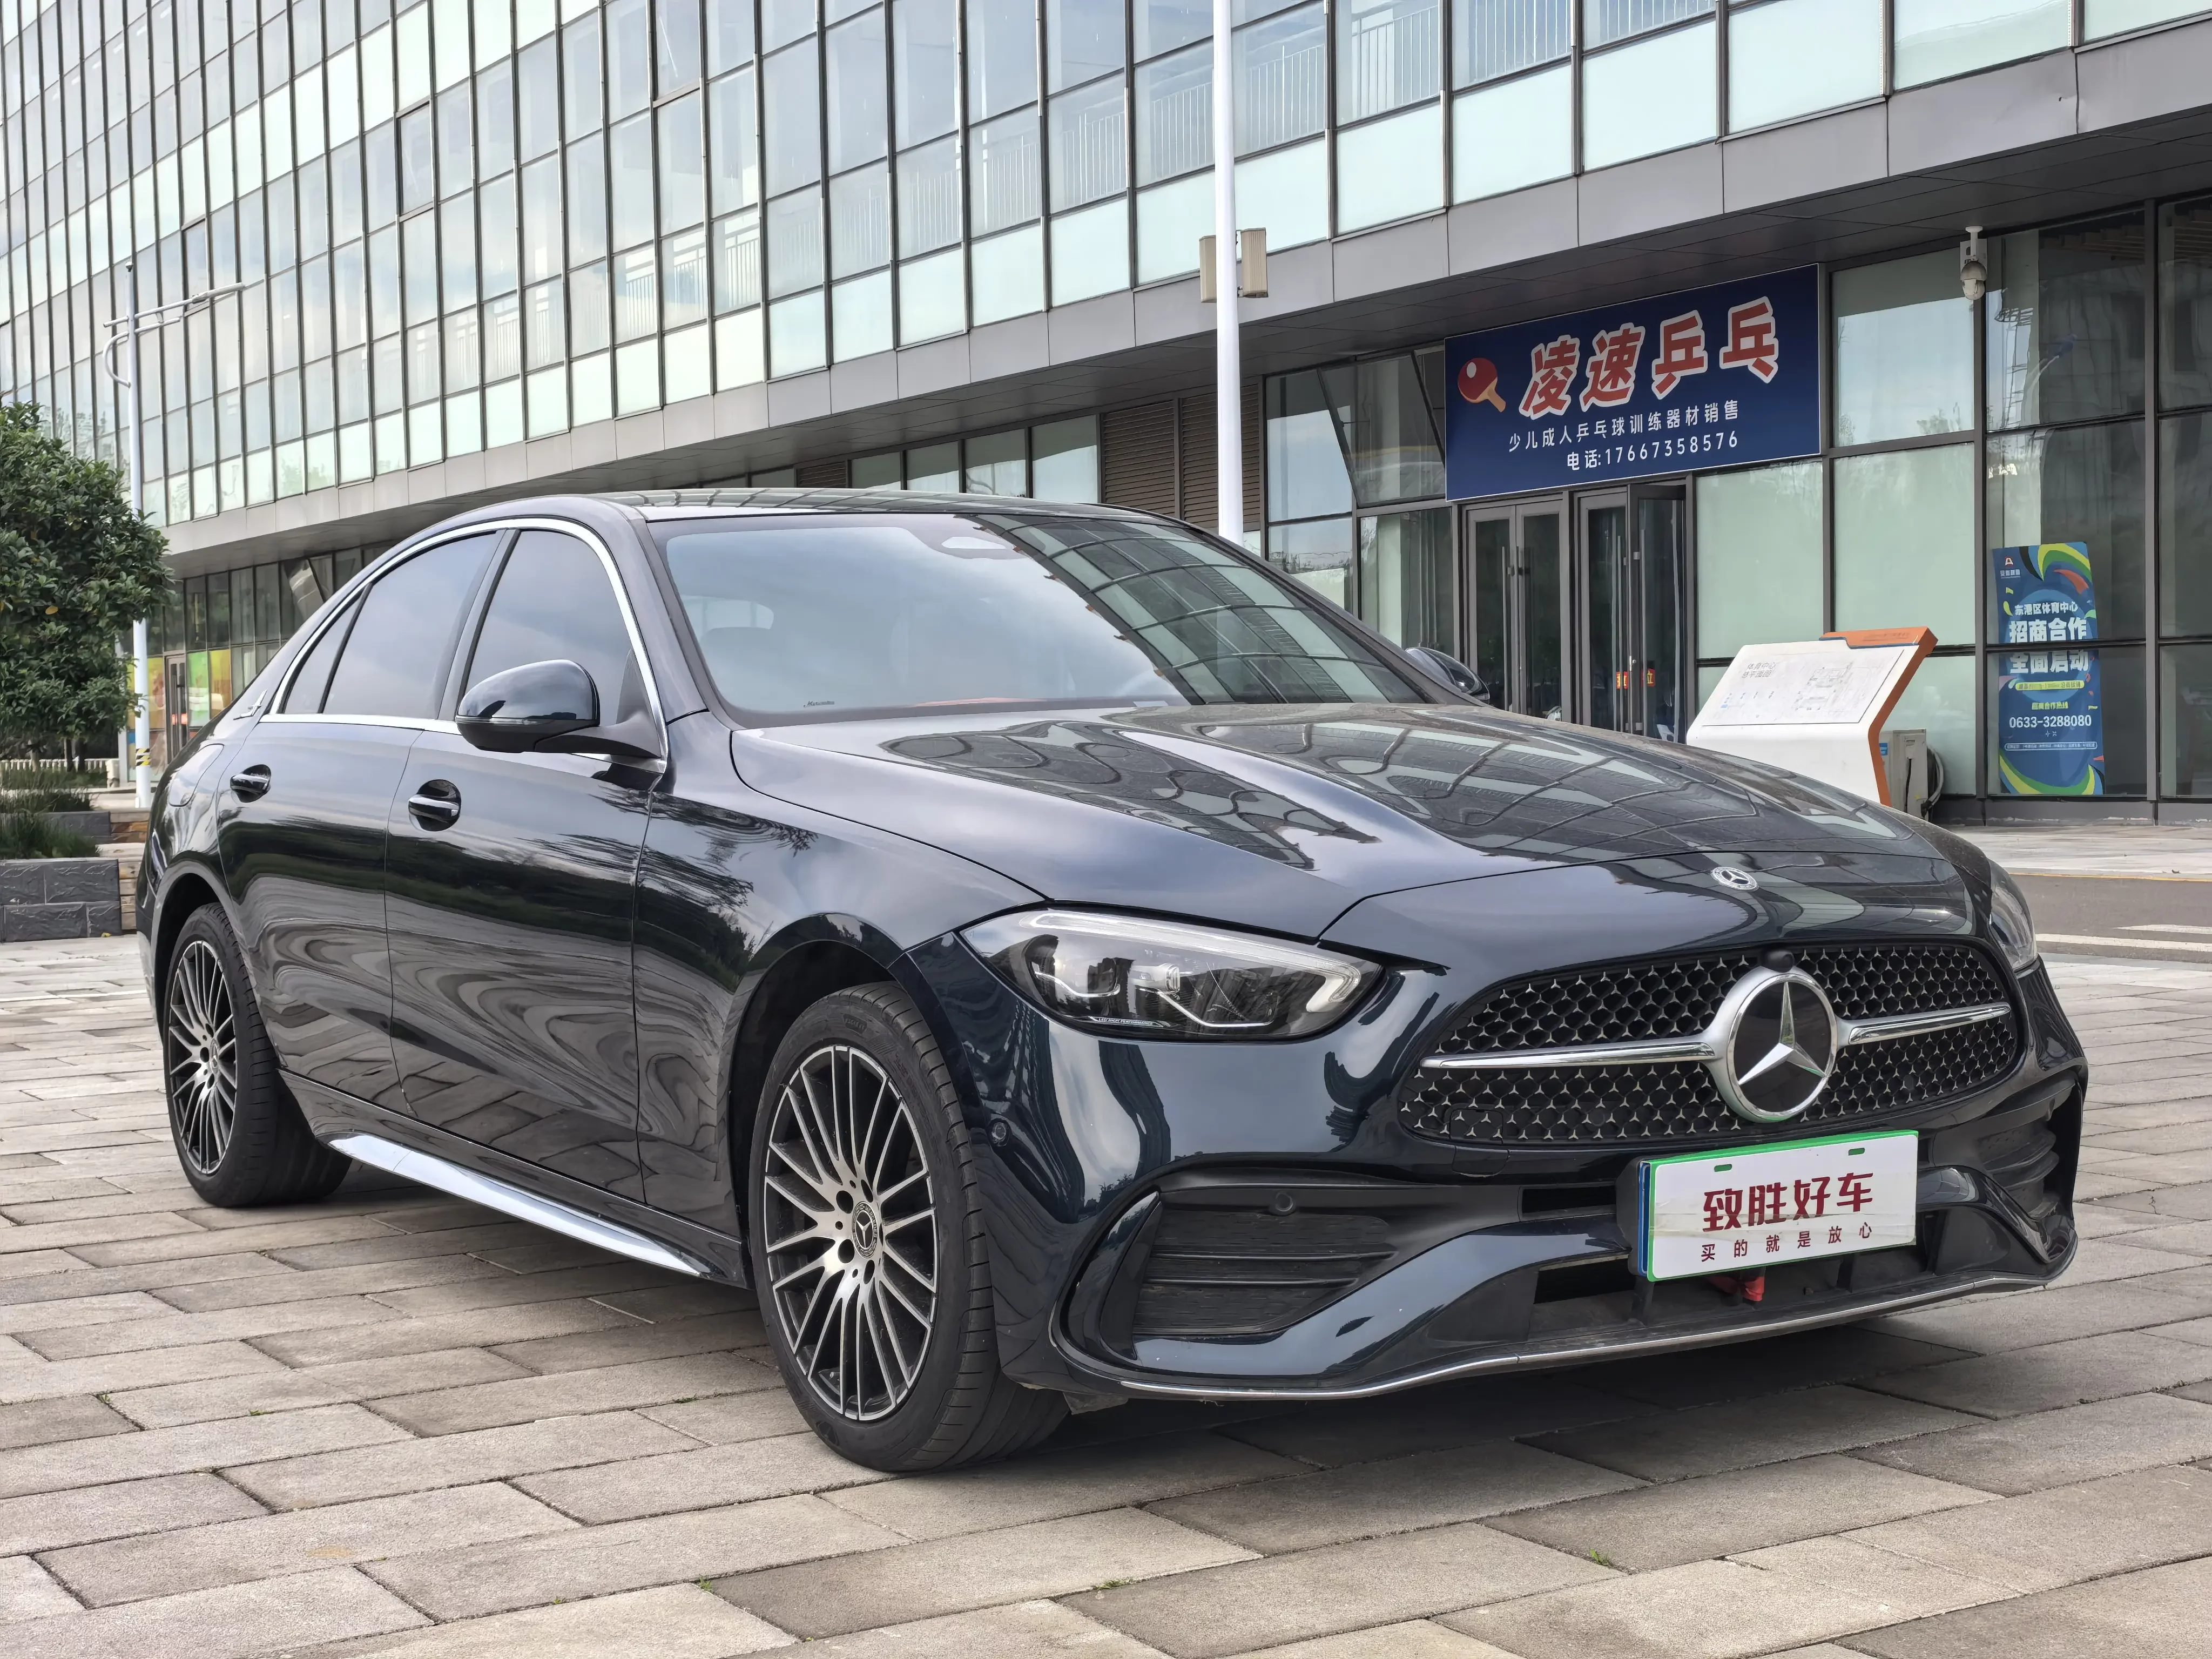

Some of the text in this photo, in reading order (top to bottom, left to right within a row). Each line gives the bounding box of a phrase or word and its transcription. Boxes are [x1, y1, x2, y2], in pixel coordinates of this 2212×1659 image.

[1519, 296, 1778, 420] 凌速乒乓
[1509, 400, 1739, 453] 少儿成人乒乓球训练器材销售
[2009, 617, 2087, 643] 招商合作
[2010, 649, 2088, 674] 全面启动
[2009, 714, 2092, 728] 0633-3288080
[1703, 1172, 1873, 1232] 致胜好车
[1701, 1222, 1872, 1262] 买的就是放心
